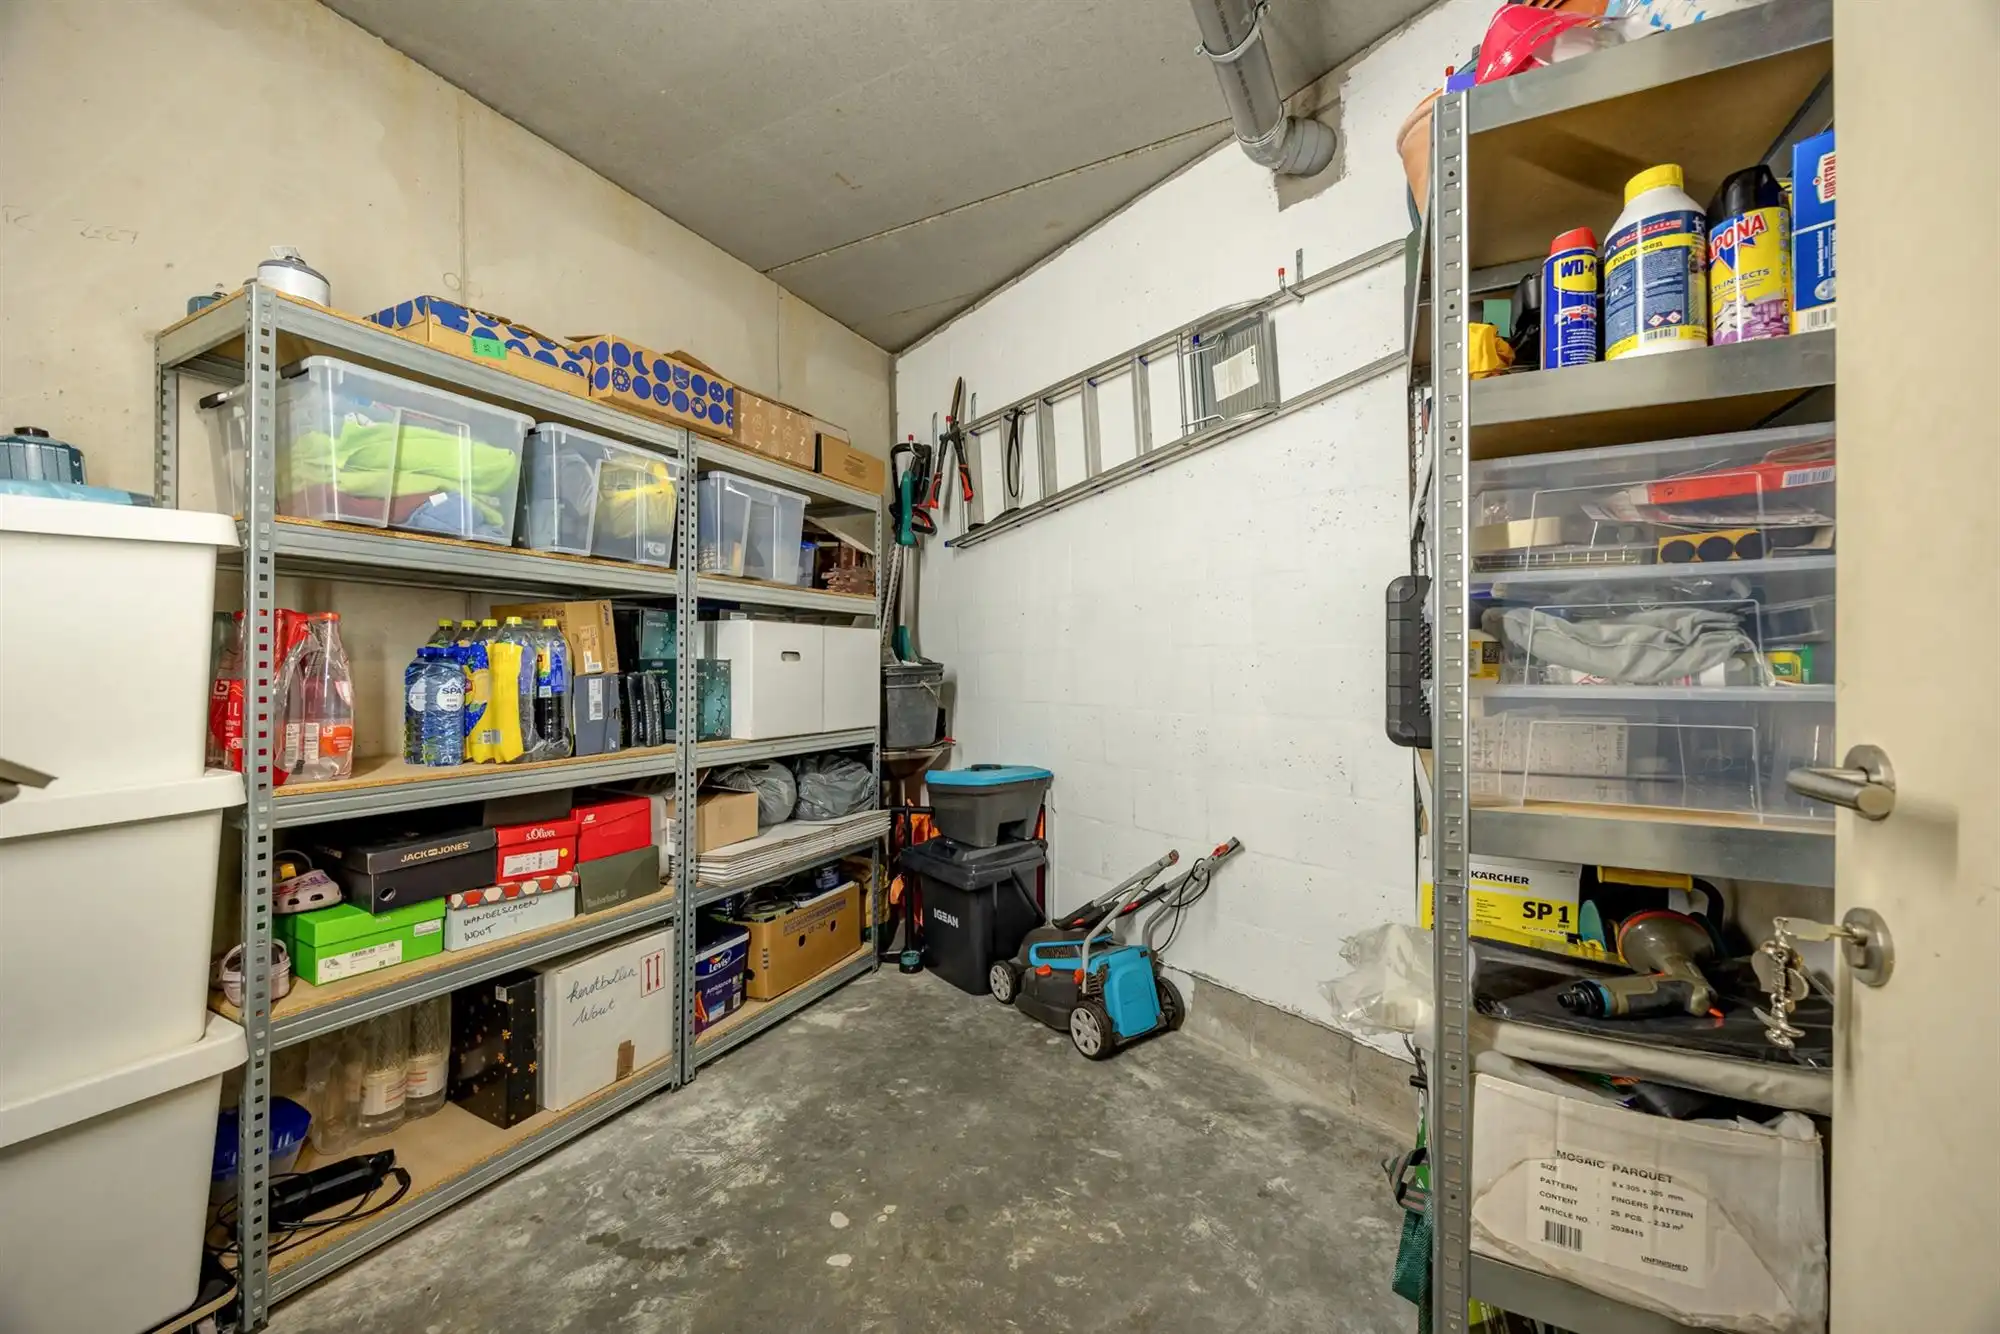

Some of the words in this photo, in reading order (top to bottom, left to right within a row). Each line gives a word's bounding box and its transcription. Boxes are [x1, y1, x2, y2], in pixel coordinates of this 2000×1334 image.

[442, 687, 462, 695] SPA
[401, 849, 427, 863] JACK
[438, 842, 469, 855] JONES
[1471, 870, 1529, 885] KÄRCHER
[1523, 901, 1553, 920] SP
[1558, 905, 1570, 924] 1
[464, 923, 496, 941] WOUT
[1556, 1150, 1605, 1169] MOSAIC
[1612, 1163, 1673, 1184] PARQUET
[1540, 1177, 1578, 1192] PATTERN
[1539, 1190, 1578, 1206] CONTENT
[1539, 1204, 1573, 1220] ARTICLE
[1611, 1196, 1649, 1210] FINGERS
[1653, 1204, 1694, 1219] PATTERN
